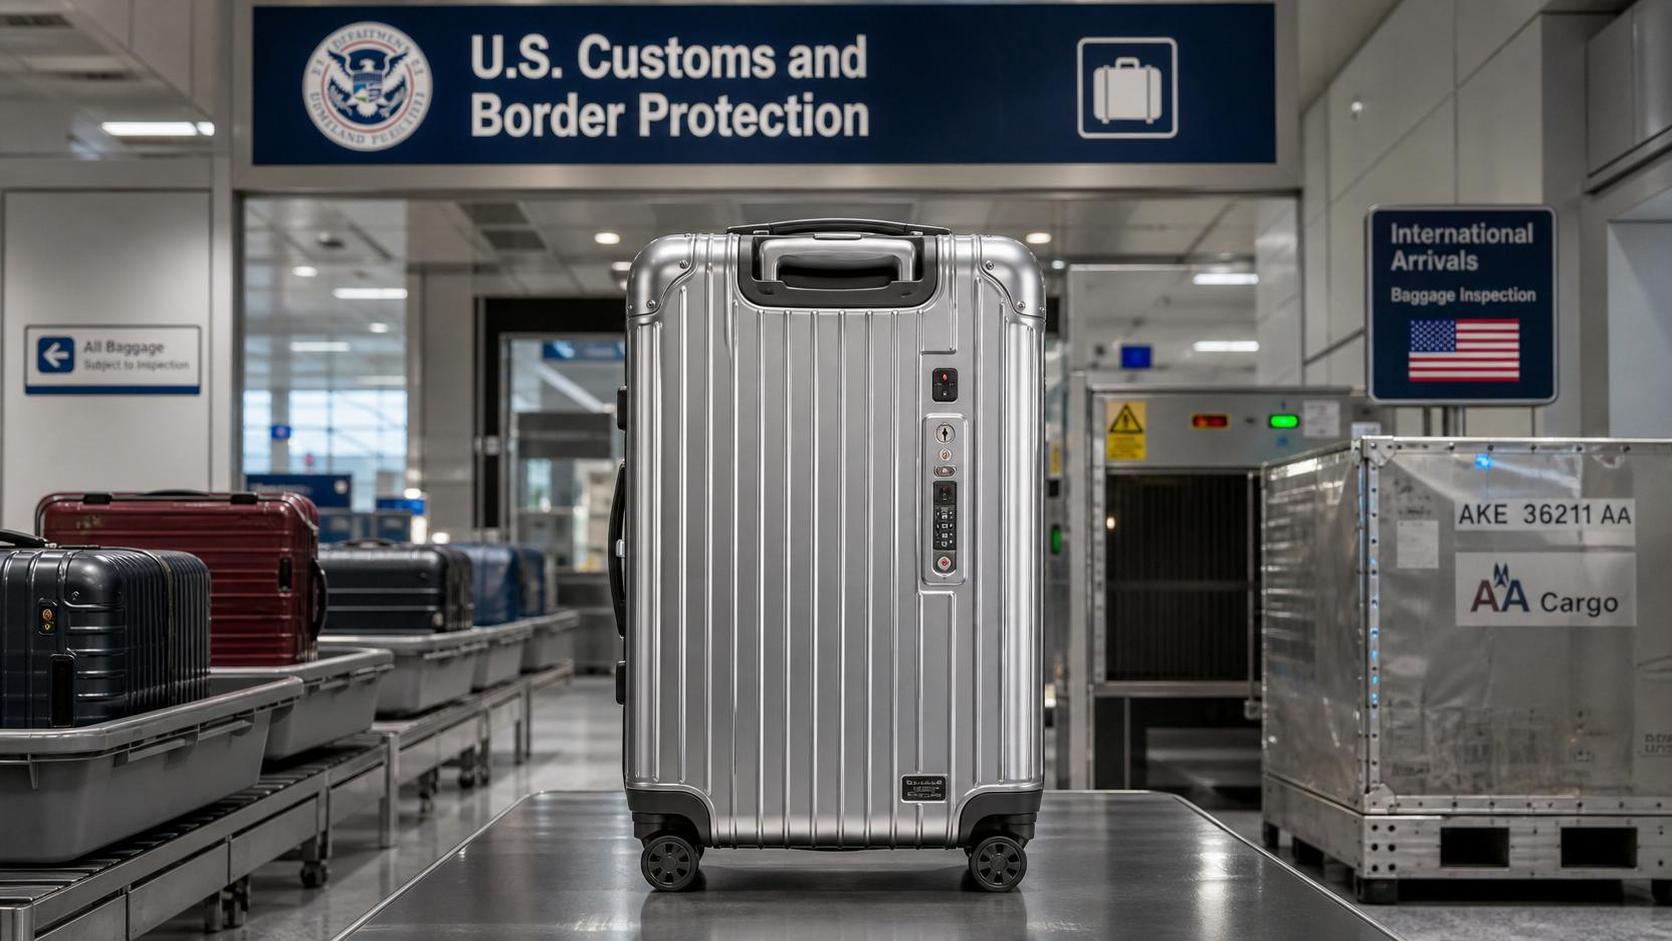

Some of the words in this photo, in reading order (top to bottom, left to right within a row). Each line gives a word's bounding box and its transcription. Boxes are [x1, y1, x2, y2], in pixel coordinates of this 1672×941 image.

[471, 33, 563, 80] U.S.
[577, 33, 777, 80] Customs
[787, 34, 868, 79] and
[471, 92, 626, 138] Border
[639, 92, 870, 138] Protection
[1391, 222, 1534, 245] International
[1390, 250, 1479, 272] Arrivals
[1390, 287, 1456, 306] Baggage
[1459, 287, 1537, 305] Inspection
[83, 340, 102, 353] All
[105, 340, 165, 357] Baggage
[124, 360, 134, 370] to
[1458, 503, 1508, 525] AKE
[1523, 503, 1591, 525] 36211
[1600, 504, 1632, 525] AA
[1470, 579, 1531, 613] AA
[1540, 591, 1619, 618] Cargo
